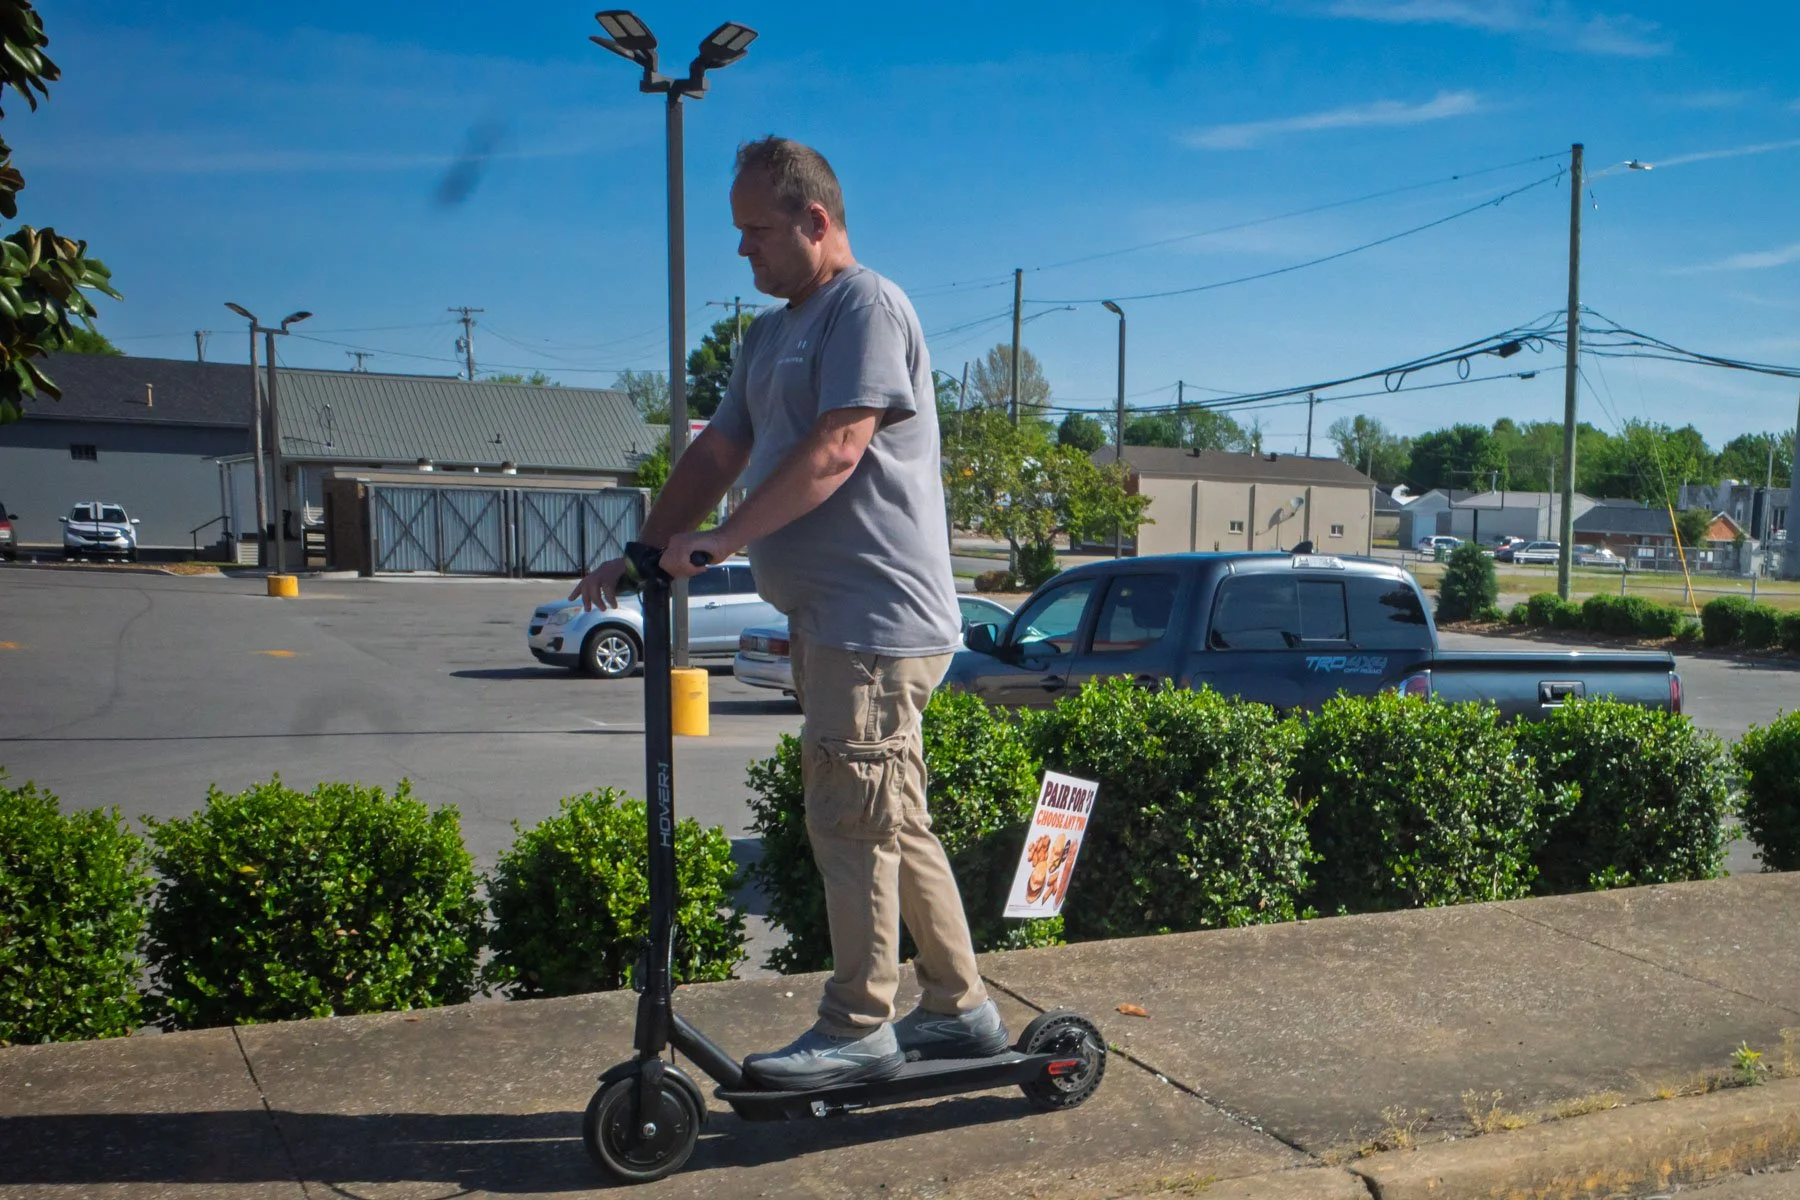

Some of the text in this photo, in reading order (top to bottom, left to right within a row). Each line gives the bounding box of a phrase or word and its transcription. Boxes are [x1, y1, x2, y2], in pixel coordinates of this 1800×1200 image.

[1306, 656, 1346, 672] TRD
[1041, 780, 1070, 809] PAIR
[1066, 787, 1087, 812] FOR
[1036, 809, 1065, 828] CHOOSE
[1062, 814, 1077, 830] ANY
